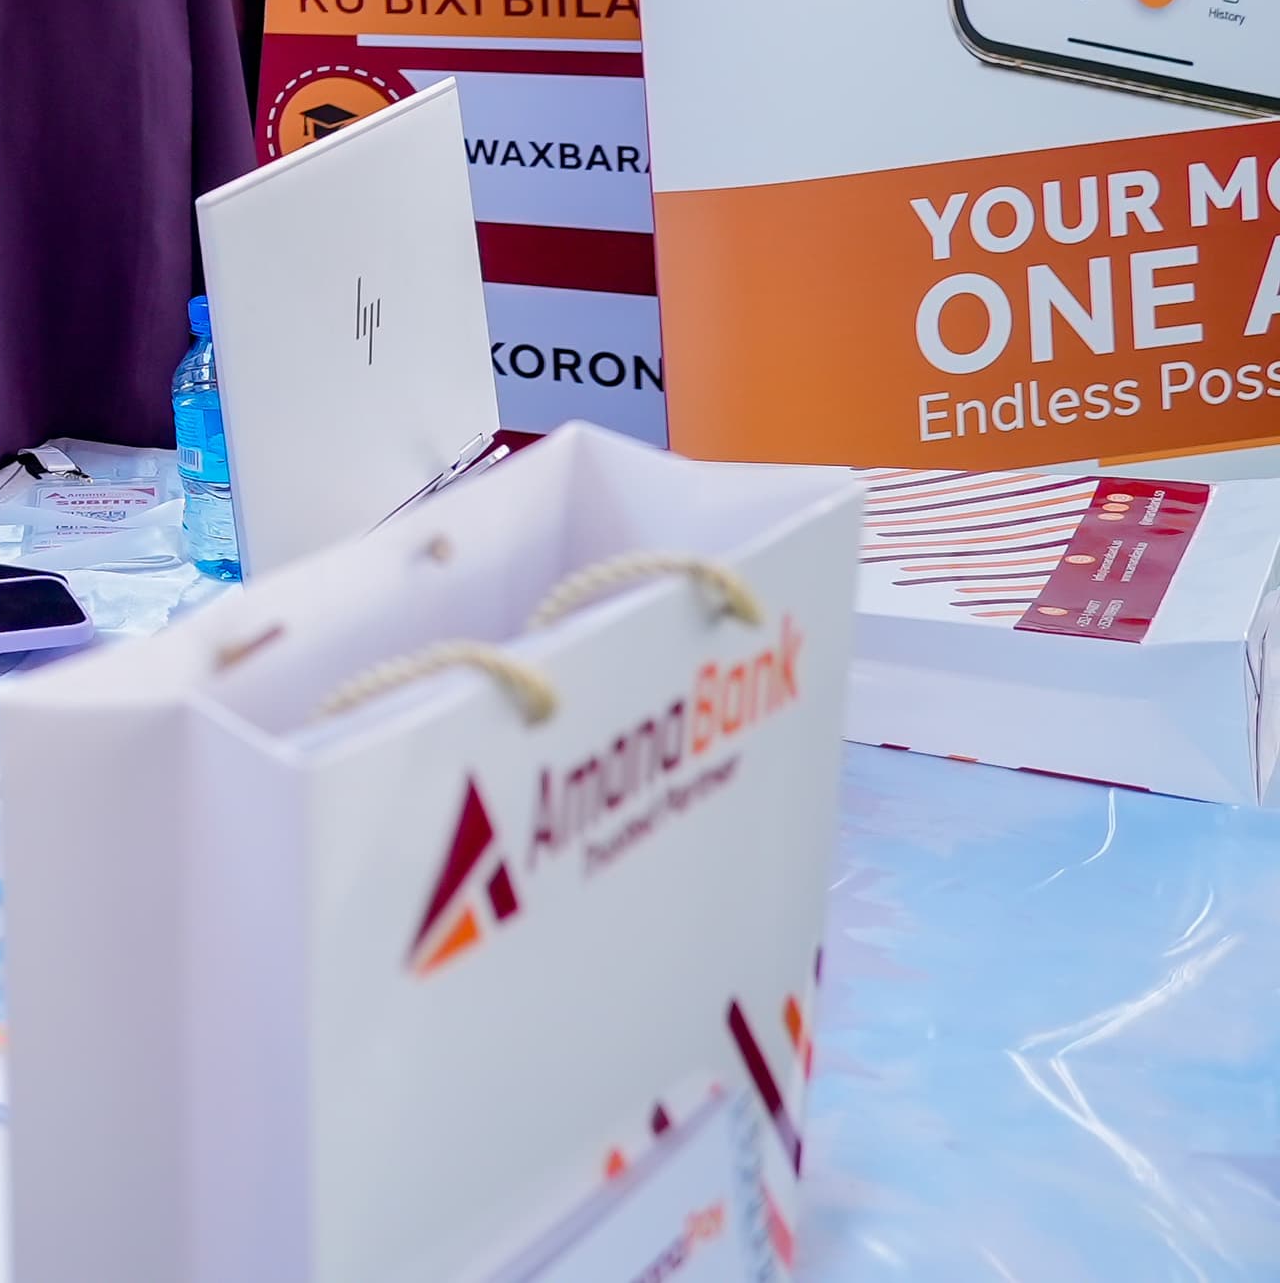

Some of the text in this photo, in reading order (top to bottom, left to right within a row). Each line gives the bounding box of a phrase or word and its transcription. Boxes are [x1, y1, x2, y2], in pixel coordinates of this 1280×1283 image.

[1209, 8, 1245, 25] History
[464, 139, 652, 173] WAXBAR
[910, 169, 1163, 260] YOUR
[916, 246, 1202, 375] ONE
[919, 379, 1140, 441] Endless
